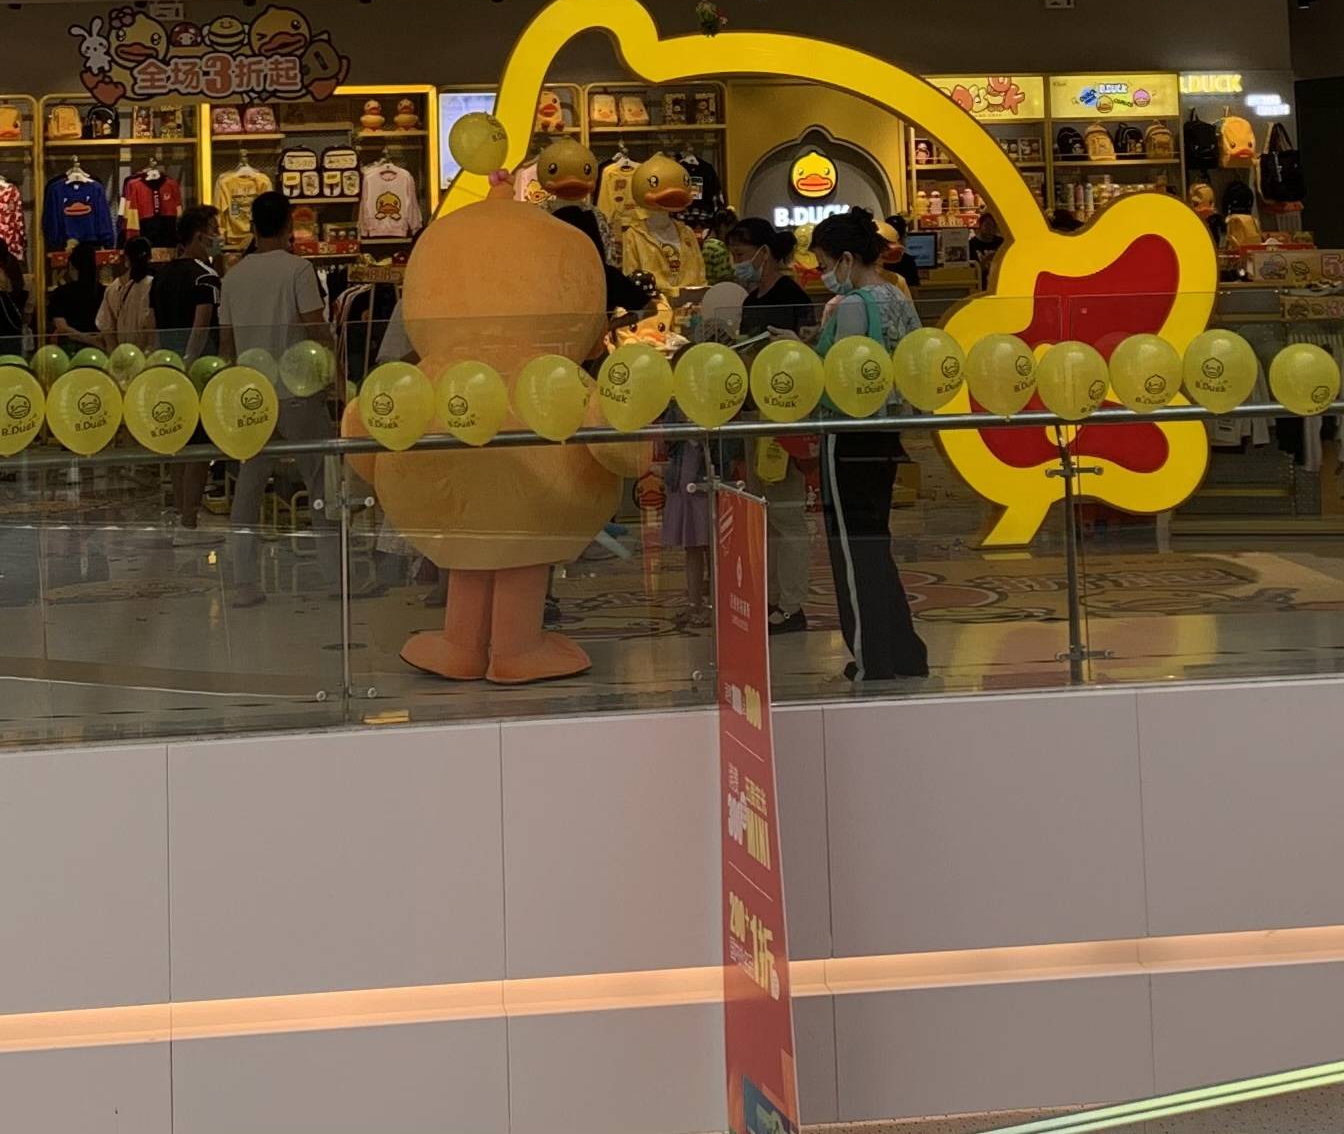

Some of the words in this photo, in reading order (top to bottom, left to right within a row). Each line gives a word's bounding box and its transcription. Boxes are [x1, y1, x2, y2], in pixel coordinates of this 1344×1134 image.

[132, 52, 302, 98] 全场3折起
[1179, 74, 1244, 94] .DUCK
[598, 386, 629, 404] B.Duck
[1, 423, 37, 437] B.Duck
